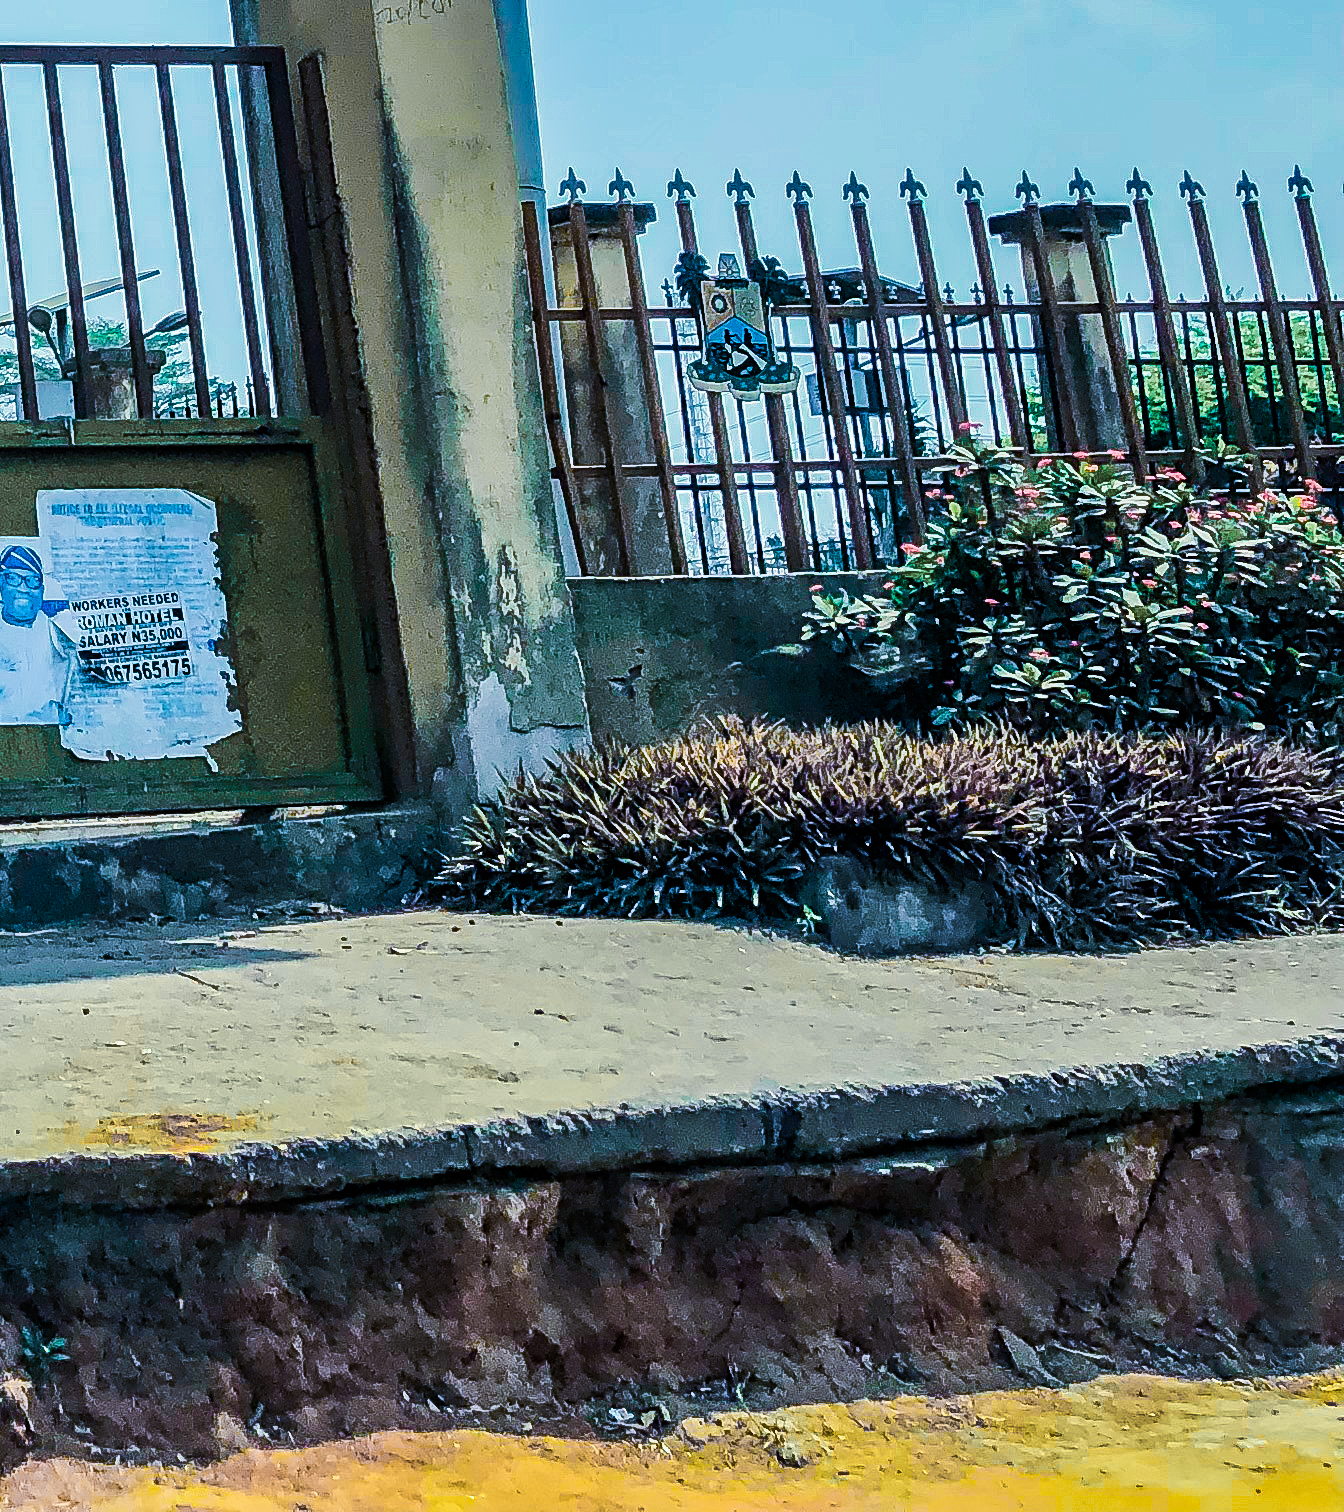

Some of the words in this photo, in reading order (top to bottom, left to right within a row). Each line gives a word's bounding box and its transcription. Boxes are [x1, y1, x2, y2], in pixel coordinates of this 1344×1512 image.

[71, 597, 129, 612] WORKERS
[132, 592, 179, 607] NEEDED
[132, 608, 179, 625] HOTEL
[79, 632, 127, 648] SALARY
[103, 657, 191, 681] 067565175
